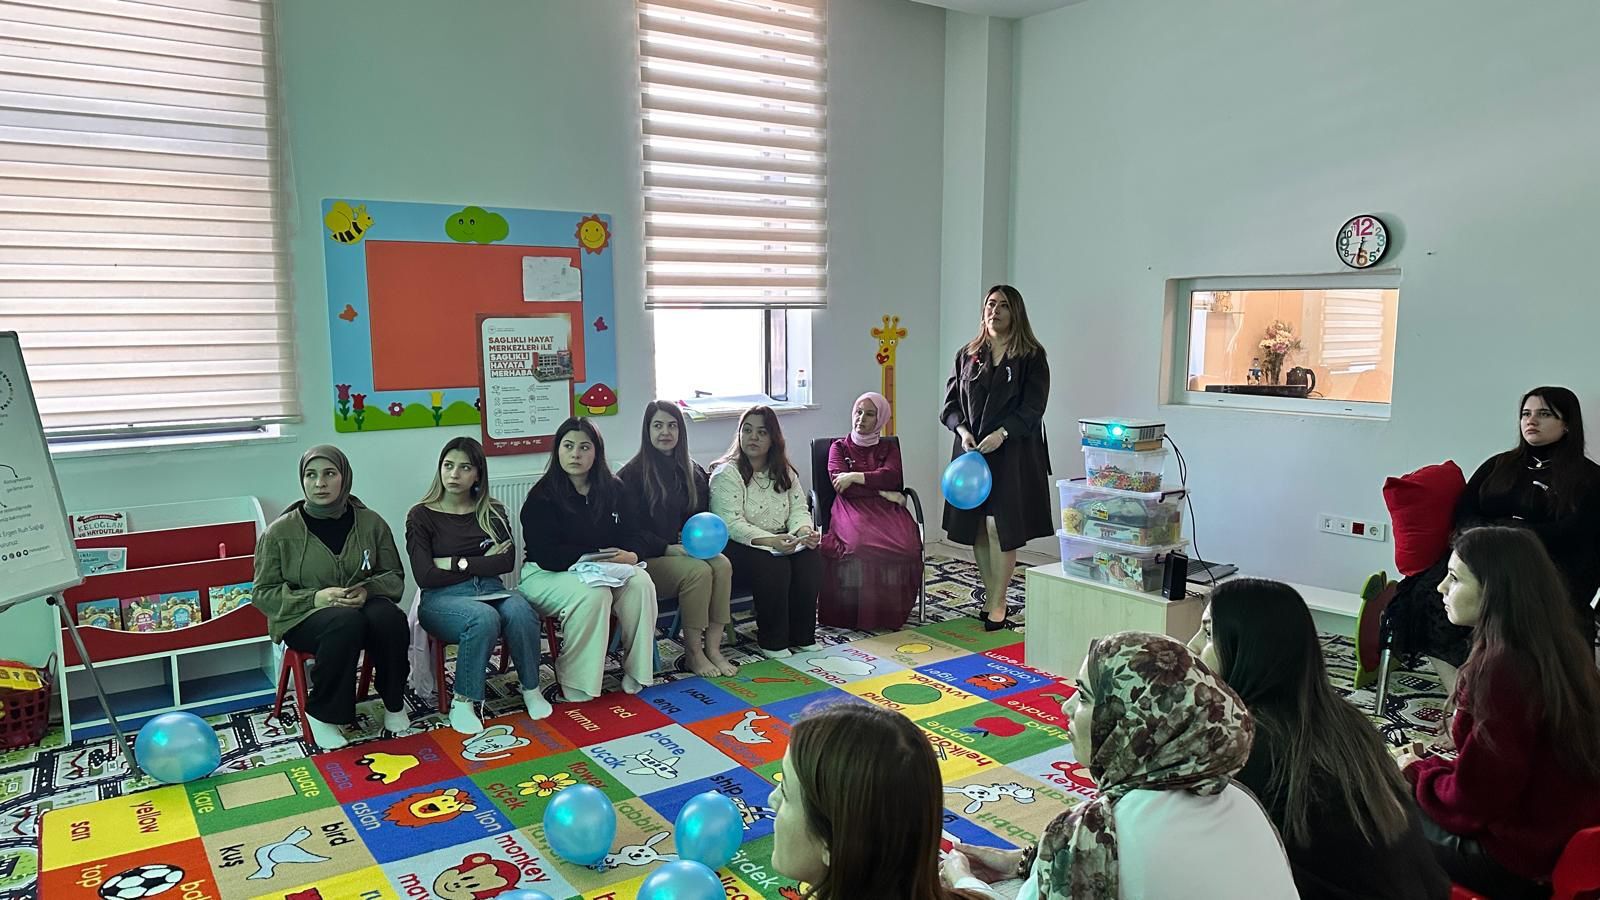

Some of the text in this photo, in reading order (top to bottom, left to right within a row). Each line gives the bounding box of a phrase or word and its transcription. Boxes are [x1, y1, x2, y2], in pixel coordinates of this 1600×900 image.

[1342, 230, 1352, 238] 10
[1353, 218, 1373, 236] 12
[1340, 236, 1350, 250] 9
[1377, 234, 1385, 247] 3
[1369, 252, 1377, 262] 5
[528, 335, 553, 343] HAYAT
[490, 361, 524, 369] HAYATA
[491, 369, 533, 377] MERHABA
[841, 648, 878, 662] bulut
[807, 668, 848, 685] cloud
[923, 668, 958, 682] tiger
[986, 662, 1041, 685] kaplan
[907, 674, 974, 700] yuvarlak
[609, 705, 638, 719] red
[653, 697, 682, 715] blue
[860, 691, 906, 712] round
[1007, 699, 1060, 722] snake
[926, 720, 976, 744] apple
[1023, 721, 1069, 740] elma
[644, 731, 686, 756] plane
[922, 729, 993, 767] helikop
[590, 746, 627, 770] uçak
[290, 766, 320, 798] square
[710, 774, 744, 797] ship
[1039, 773, 1098, 800] nkey
[192, 789, 216, 814] kare
[129, 800, 161, 834] yellow
[351, 802, 382, 831] aslan
[474, 810, 502, 833] lion
[614, 802, 665, 833] rabbit
[321, 821, 355, 847] bird
[218, 843, 245, 869] kuş
[495, 834, 552, 883] monkey
[76, 864, 108, 888] top
